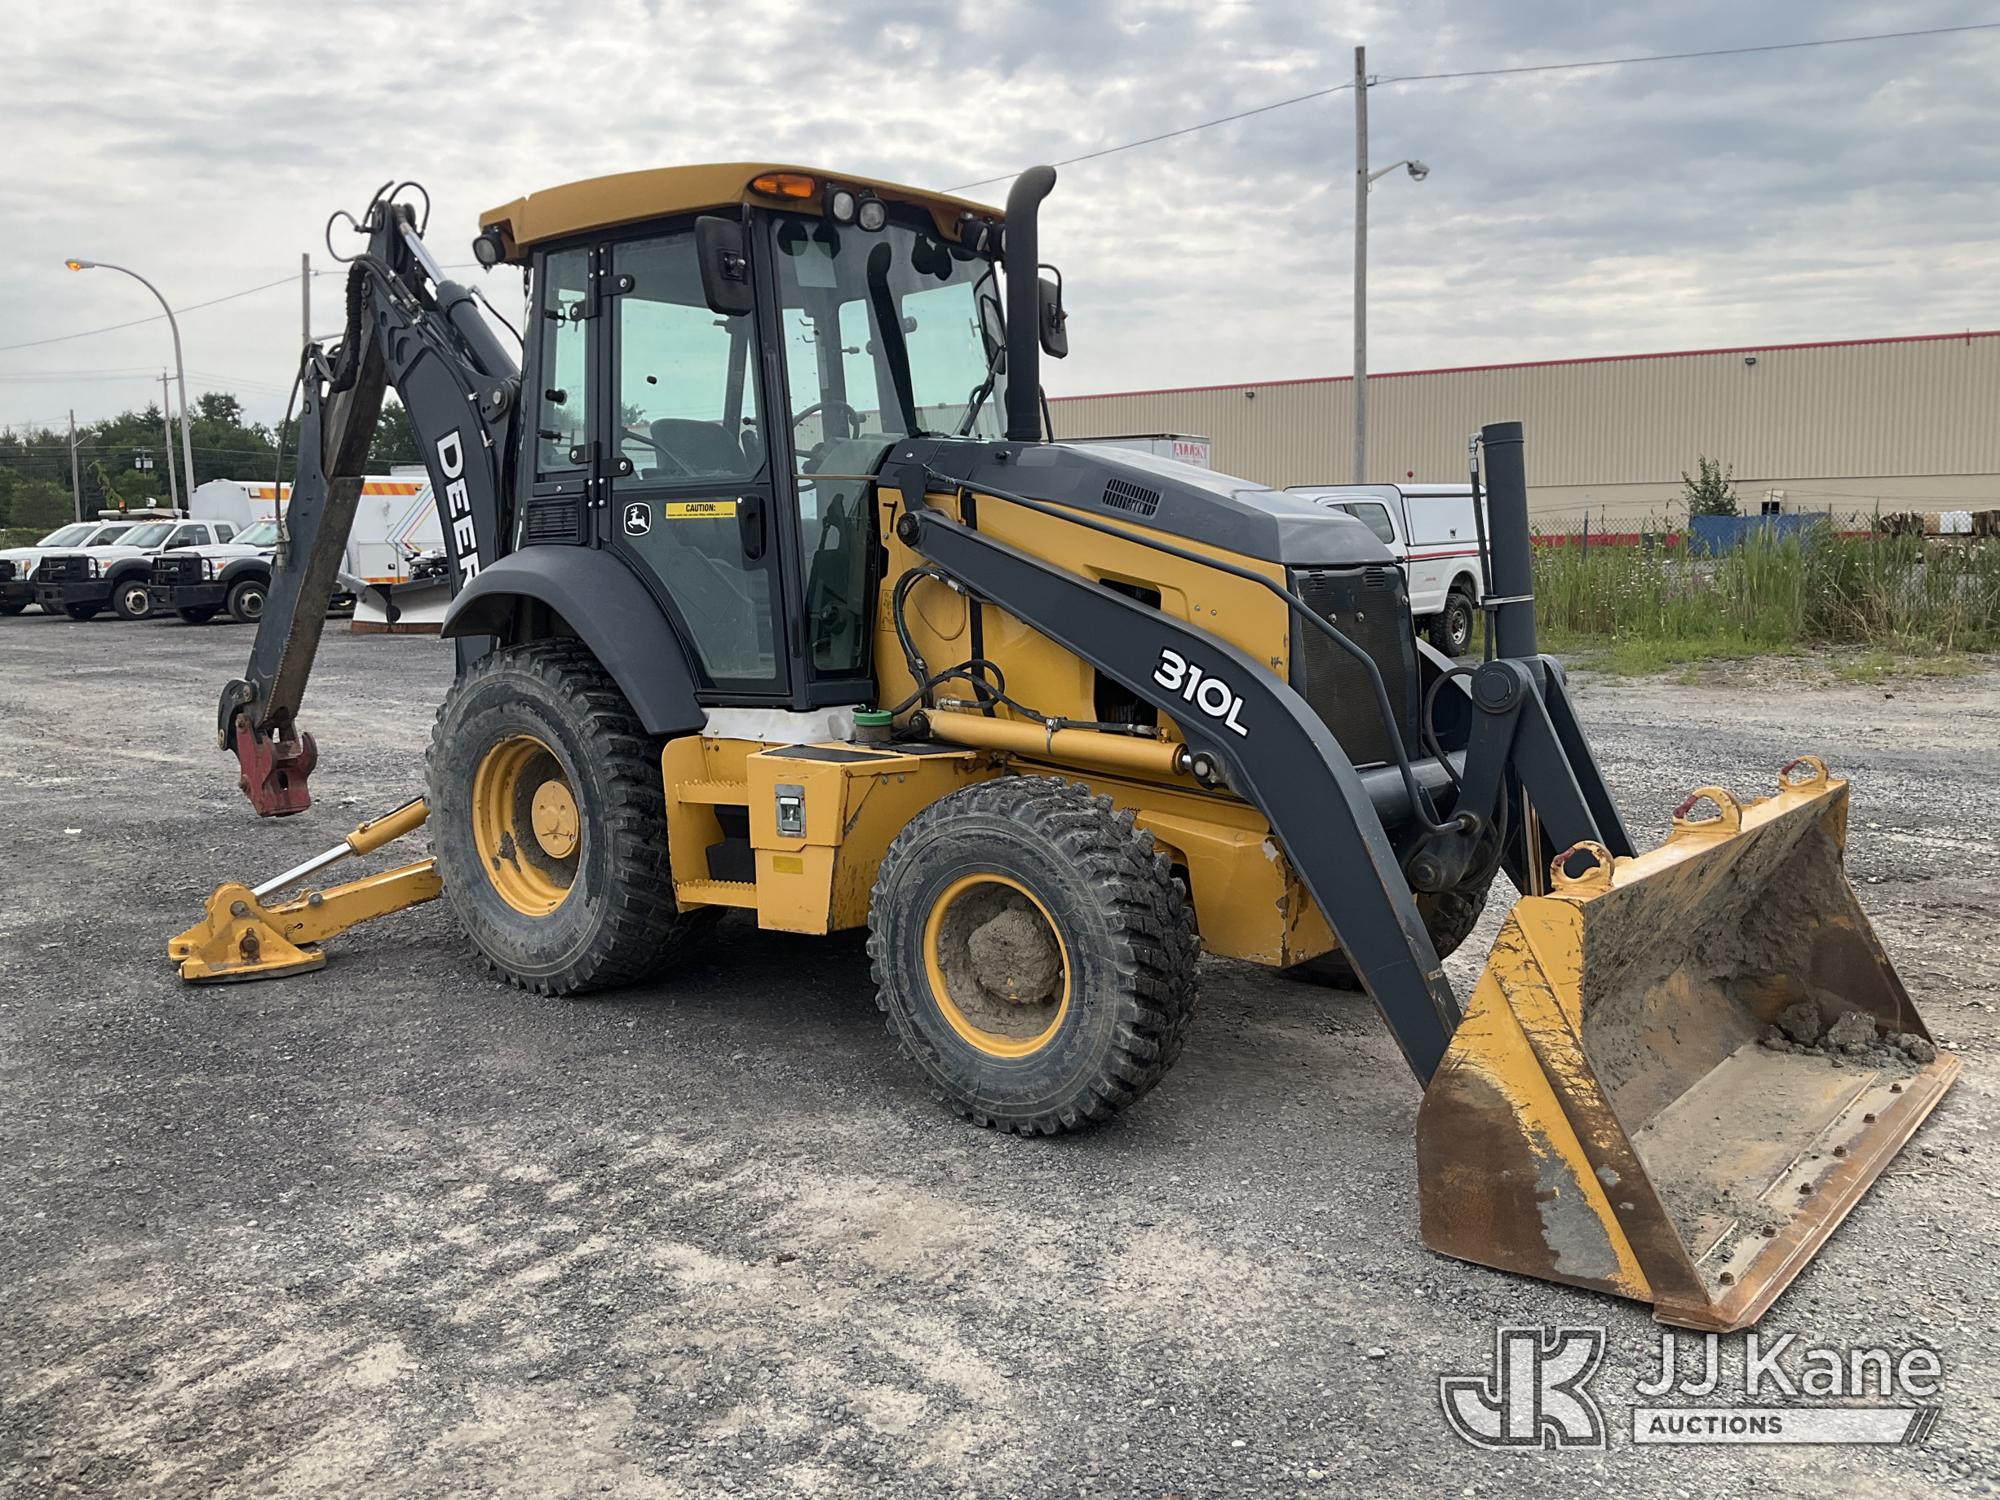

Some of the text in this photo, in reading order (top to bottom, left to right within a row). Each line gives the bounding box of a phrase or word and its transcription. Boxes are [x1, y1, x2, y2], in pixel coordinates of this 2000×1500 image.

[685, 503, 716, 512] CAUTION:
[883, 501, 898, 533] 7
[1153, 648, 1249, 737] 310L
